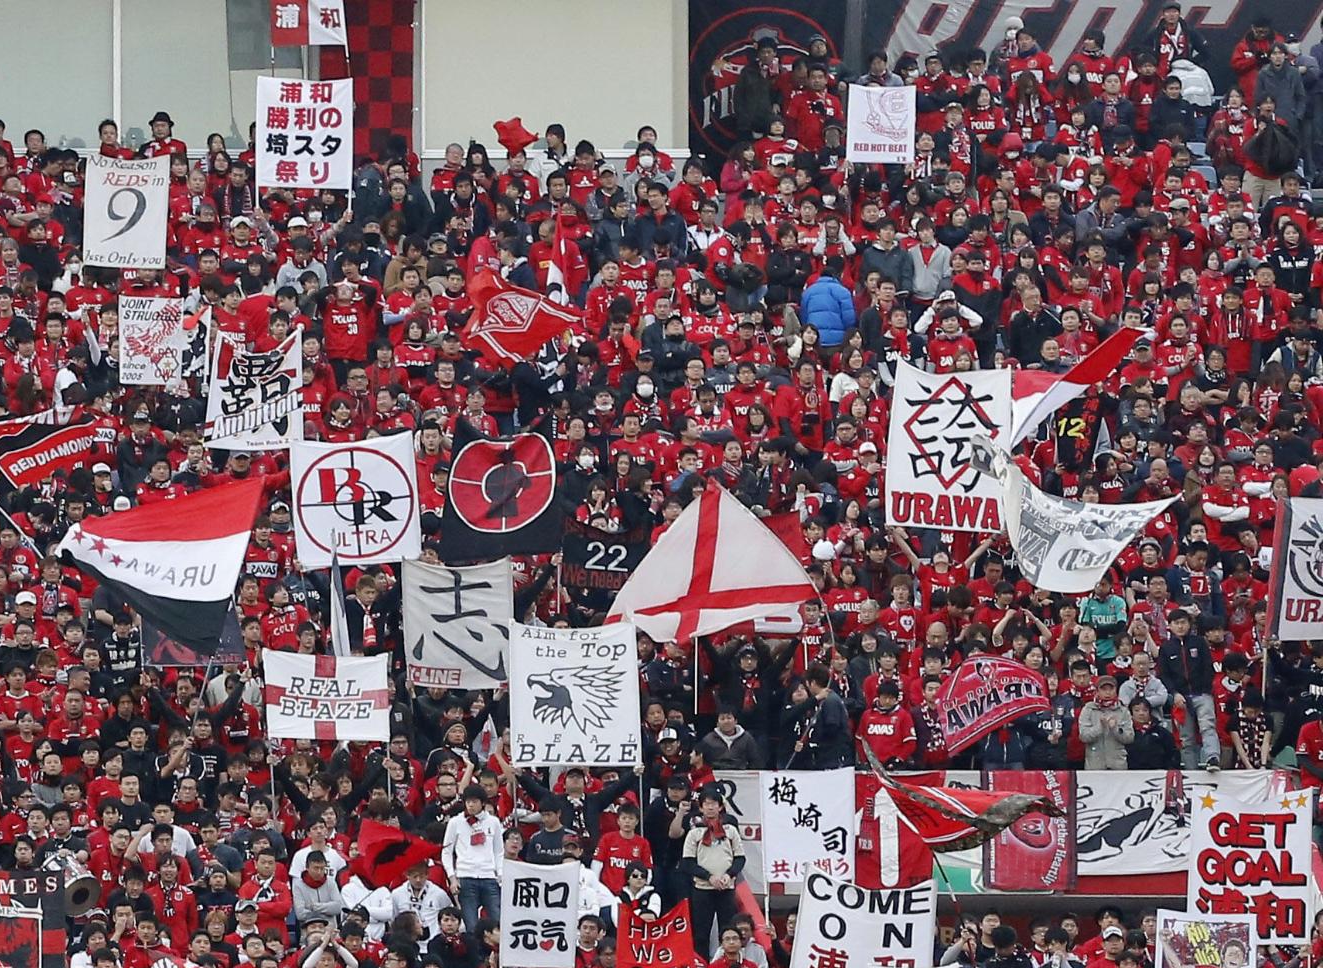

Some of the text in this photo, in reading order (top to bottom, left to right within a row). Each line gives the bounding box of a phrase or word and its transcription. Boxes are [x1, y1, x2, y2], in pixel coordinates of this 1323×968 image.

[274, 4, 343, 28] 浦和
[279, 81, 334, 104] 浦和
[266, 106, 343, 131] 勝利の
[265, 133, 343, 157] 埼スタ
[853, 142, 907, 153] RED HOT BEAT
[103, 170, 165, 188] REDS in
[274, 159, 331, 184] 祭り
[106, 187, 147, 243] 9
[121, 298, 152, 311] JOINT
[210, 389, 299, 441] Ambition
[1057, 417, 1086, 439] 12
[7, 454, 36, 475] RED
[890, 490, 1001, 528] URAWA
[584, 541, 629, 573] 22
[517, 623, 598, 642] Aim for
[531, 639, 624, 664] the Top
[286, 676, 359, 699] REAL
[278, 697, 373, 720] BLAZE
[514, 743, 635, 765] BLAZE
[1206, 812, 1295, 849] GET
[1196, 849, 1309, 889] GOAL
[512, 877, 571, 910] 原口
[806, 873, 932, 917] COME
[509, 919, 570, 952] 元気
[628, 914, 688, 942] Here
[631, 942, 673, 965] We
